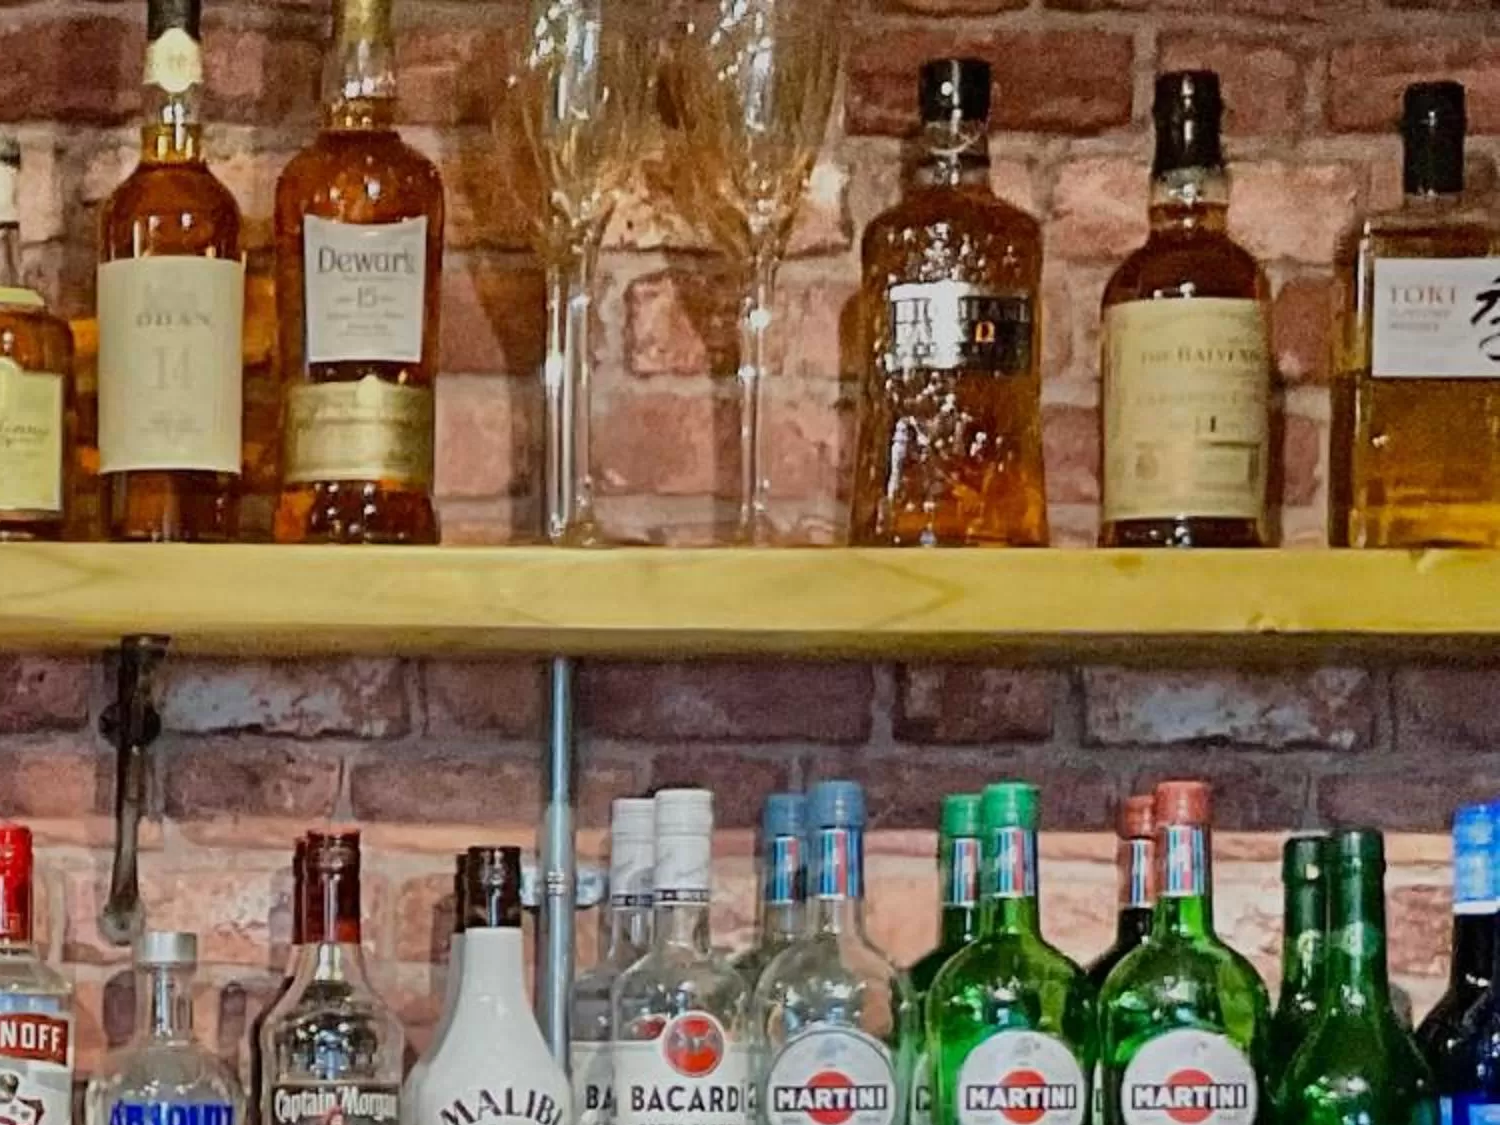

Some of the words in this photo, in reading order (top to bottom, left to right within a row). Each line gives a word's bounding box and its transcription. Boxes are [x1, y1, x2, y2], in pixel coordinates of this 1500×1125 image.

[274, 1087, 337, 1124] Captain
[775, 1086, 887, 1111] MARTINI
[967, 1085, 1077, 1109] MARTINI
[1133, 1085, 1246, 1108] MARTINI
